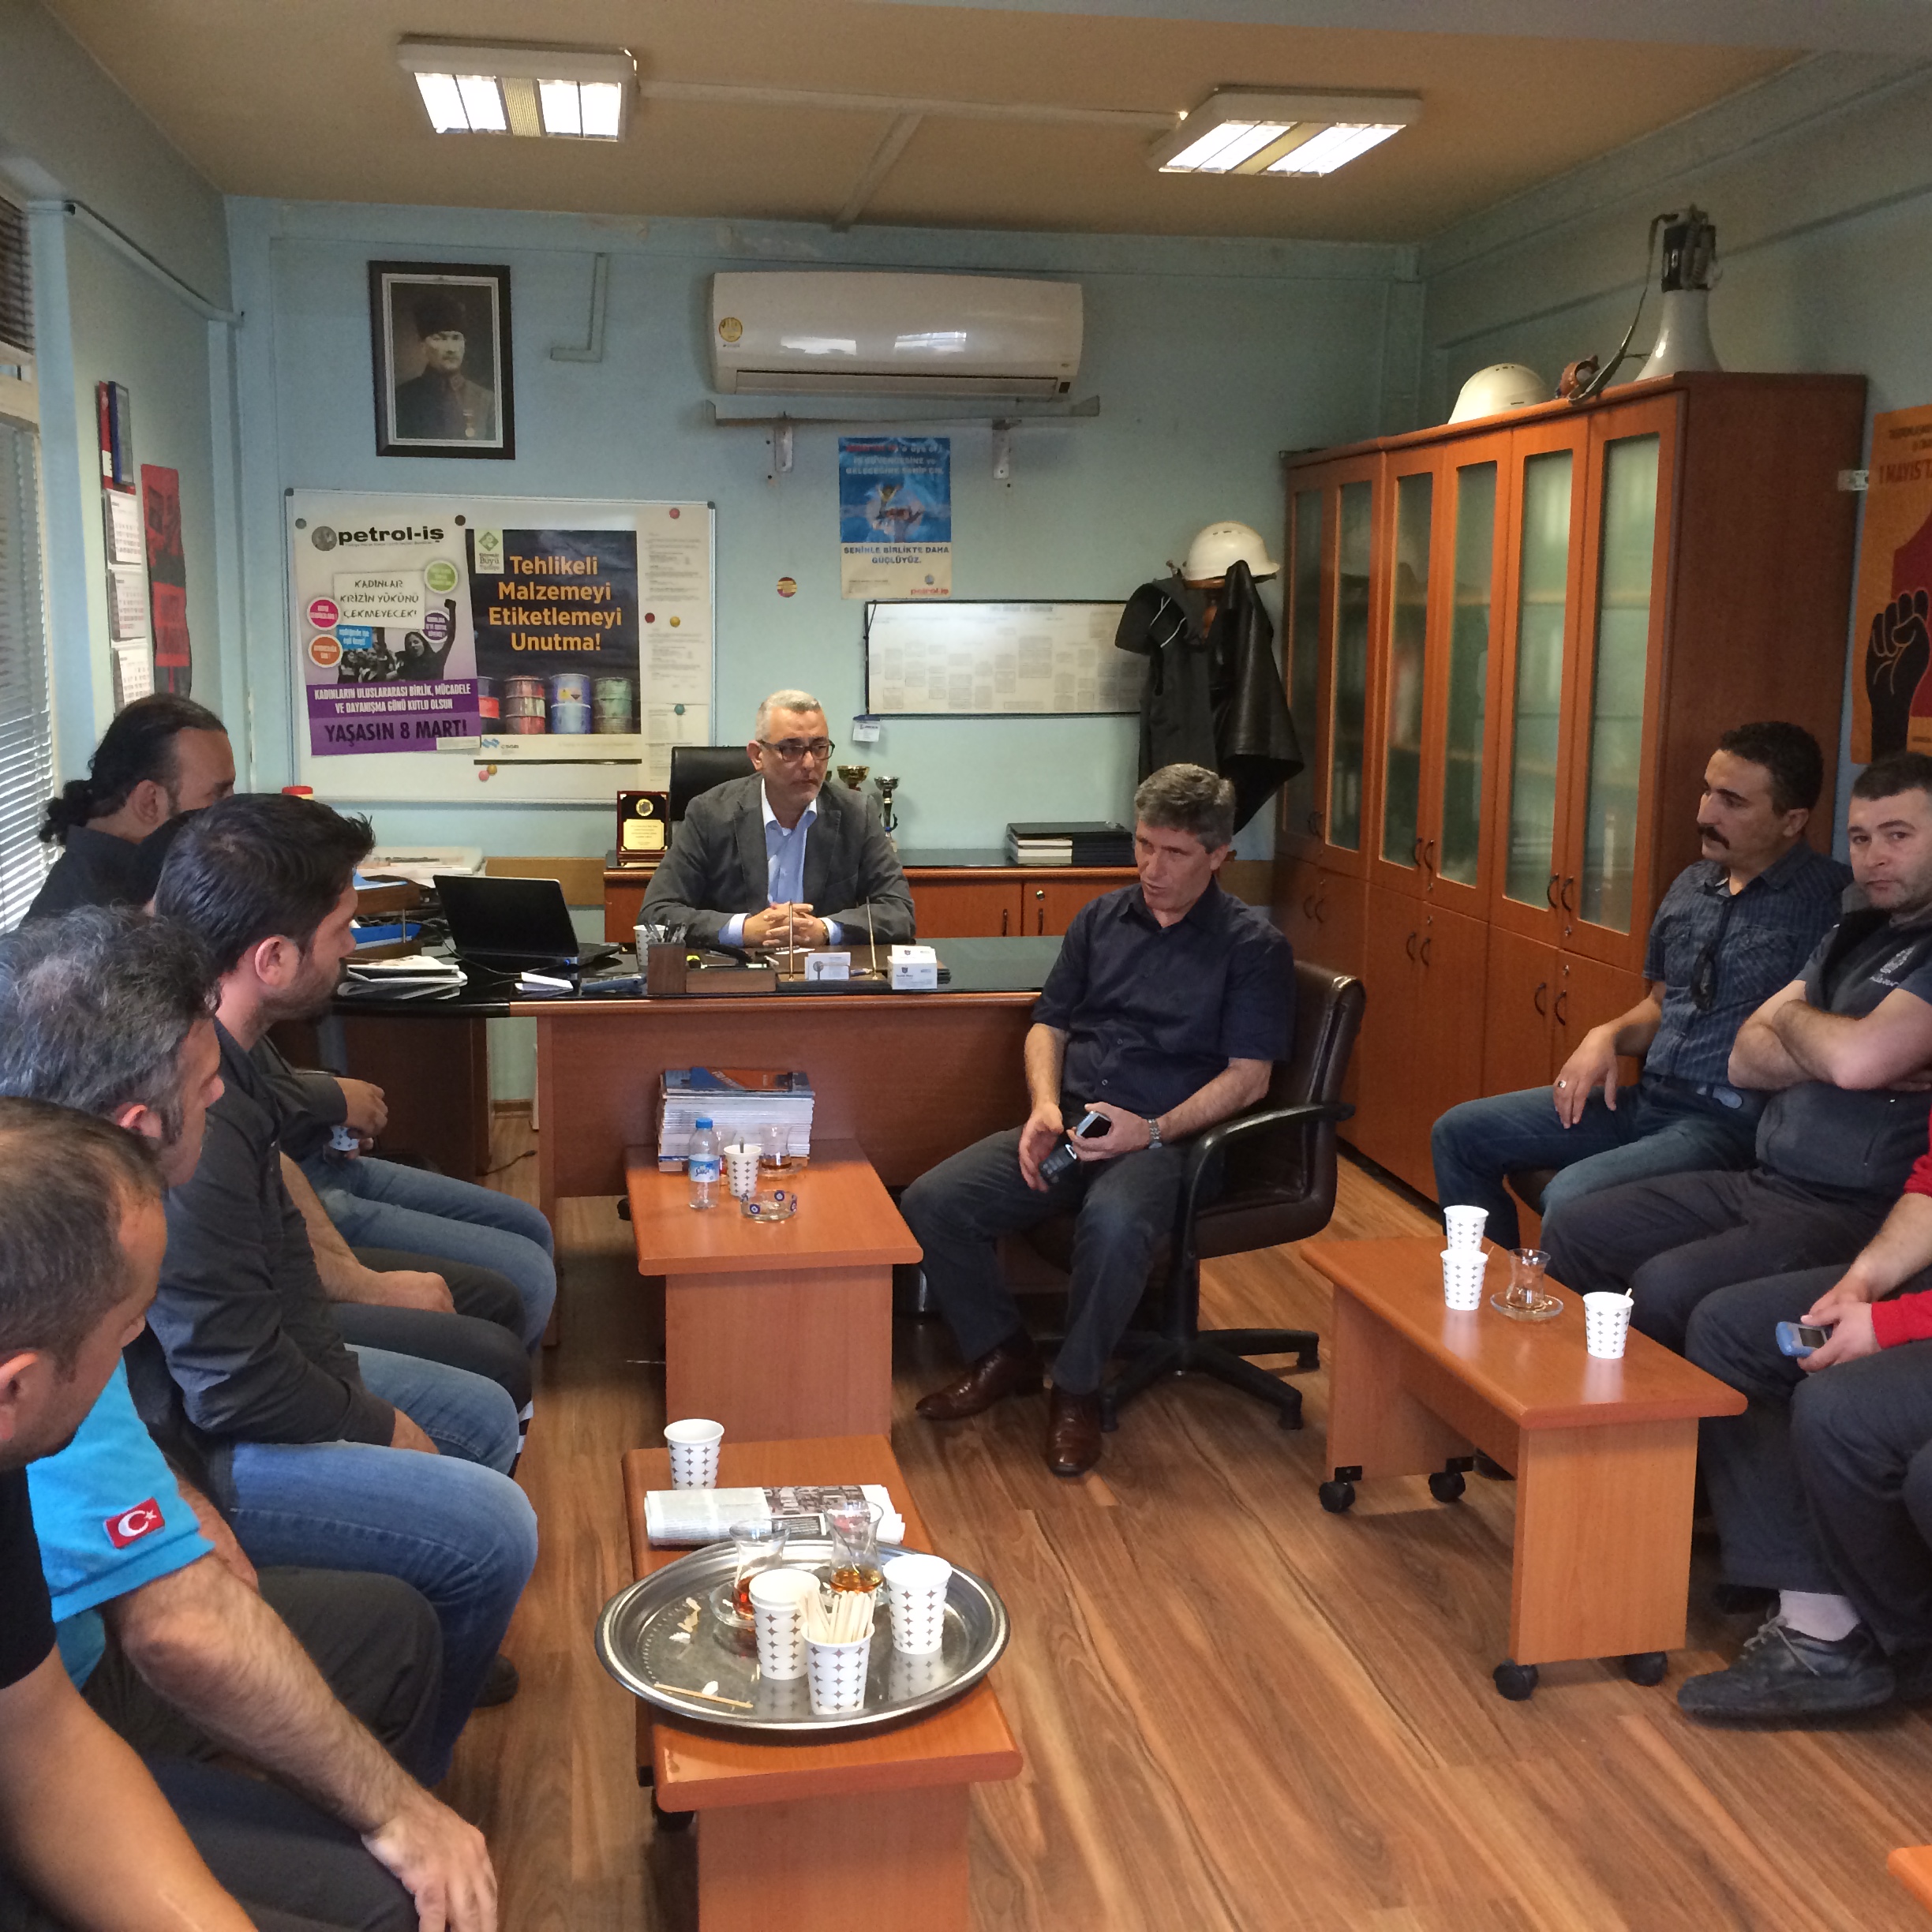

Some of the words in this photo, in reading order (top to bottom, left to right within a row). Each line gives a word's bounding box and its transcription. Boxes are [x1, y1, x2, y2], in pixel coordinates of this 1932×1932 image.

[1886, 459, 1932, 483] MAYIS'T
[338, 526, 444, 545] petrol-iş
[883, 545, 923, 554] BİRLİKTE
[509, 556, 598, 575] Tehlikeli
[354, 579, 403, 588] KADINLAR
[498, 582, 611, 604] Malzemeyi
[340, 593, 375, 603] KRİZİN
[377, 593, 419, 603] YÜKÜNÜ
[343, 608, 417, 619] ÇEKMEYECEK!
[489, 607, 622, 630] Etiketlemeyi
[511, 632, 601, 651] Unutma!
[314, 688, 356, 700] KADINLARIN
[435, 683, 471, 695] MÜCADELE
[335, 702, 345, 713] VE
[346, 701, 387, 713] DAYANIŞMA
[388, 699, 406, 712] GÜNÜ
[407, 699, 429, 711] KUTLU
[430, 698, 453, 710] OLSUN
[324, 722, 395, 747] YAŞASIN
[400, 721, 410, 739] 8
[416, 720, 468, 739] MART!
